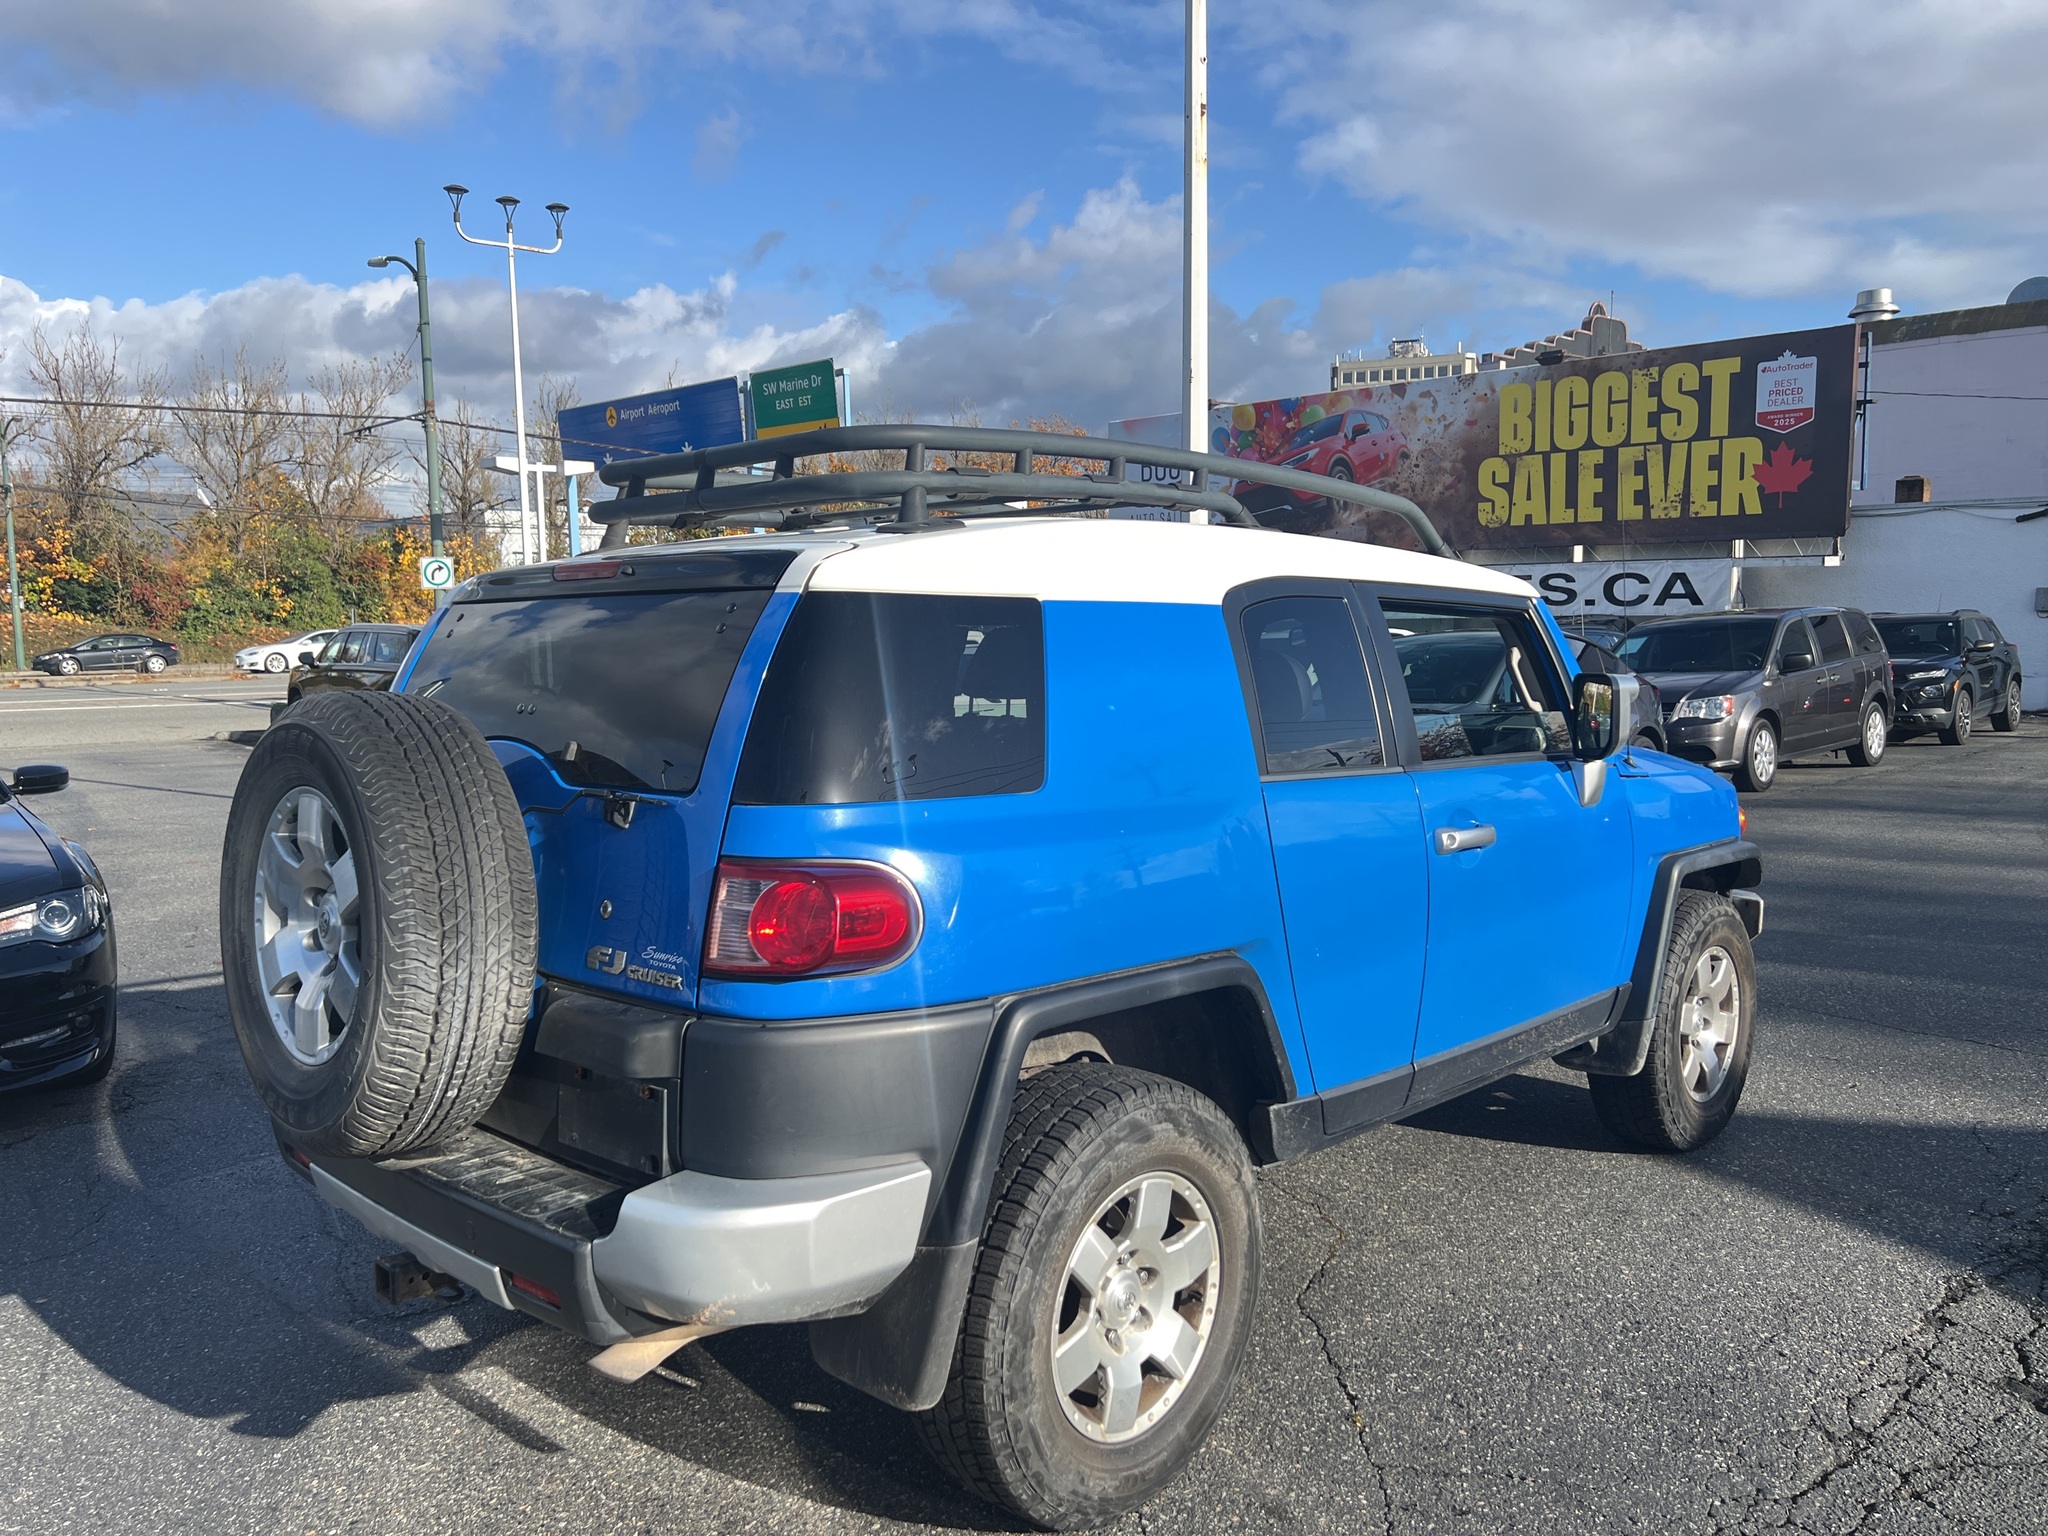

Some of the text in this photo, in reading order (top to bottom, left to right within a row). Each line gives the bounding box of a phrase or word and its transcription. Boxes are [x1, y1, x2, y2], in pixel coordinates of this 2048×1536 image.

[1766, 362, 1813, 374] AutoTrader
[762, 374, 822, 396] SW Marine Dr
[1774, 378, 1798, 388] BEST
[1768, 387, 1804, 398] PRICED
[775, 395, 812, 410] EAST EST
[1499, 356, 1742, 456] BIGGEST
[1767, 396, 1804, 407] DEALER
[620, 400, 681, 422] Airport Aéroport
[1774, 417, 1795, 426] 2025
[1477, 436, 1764, 529] SALE EVER
[1512, 572, 1704, 607] S.CA
[641, 946, 684, 964] Sunrise
[587, 944, 684, 991] FJ CRUISER
[649, 960, 677, 970] TOYOTA
